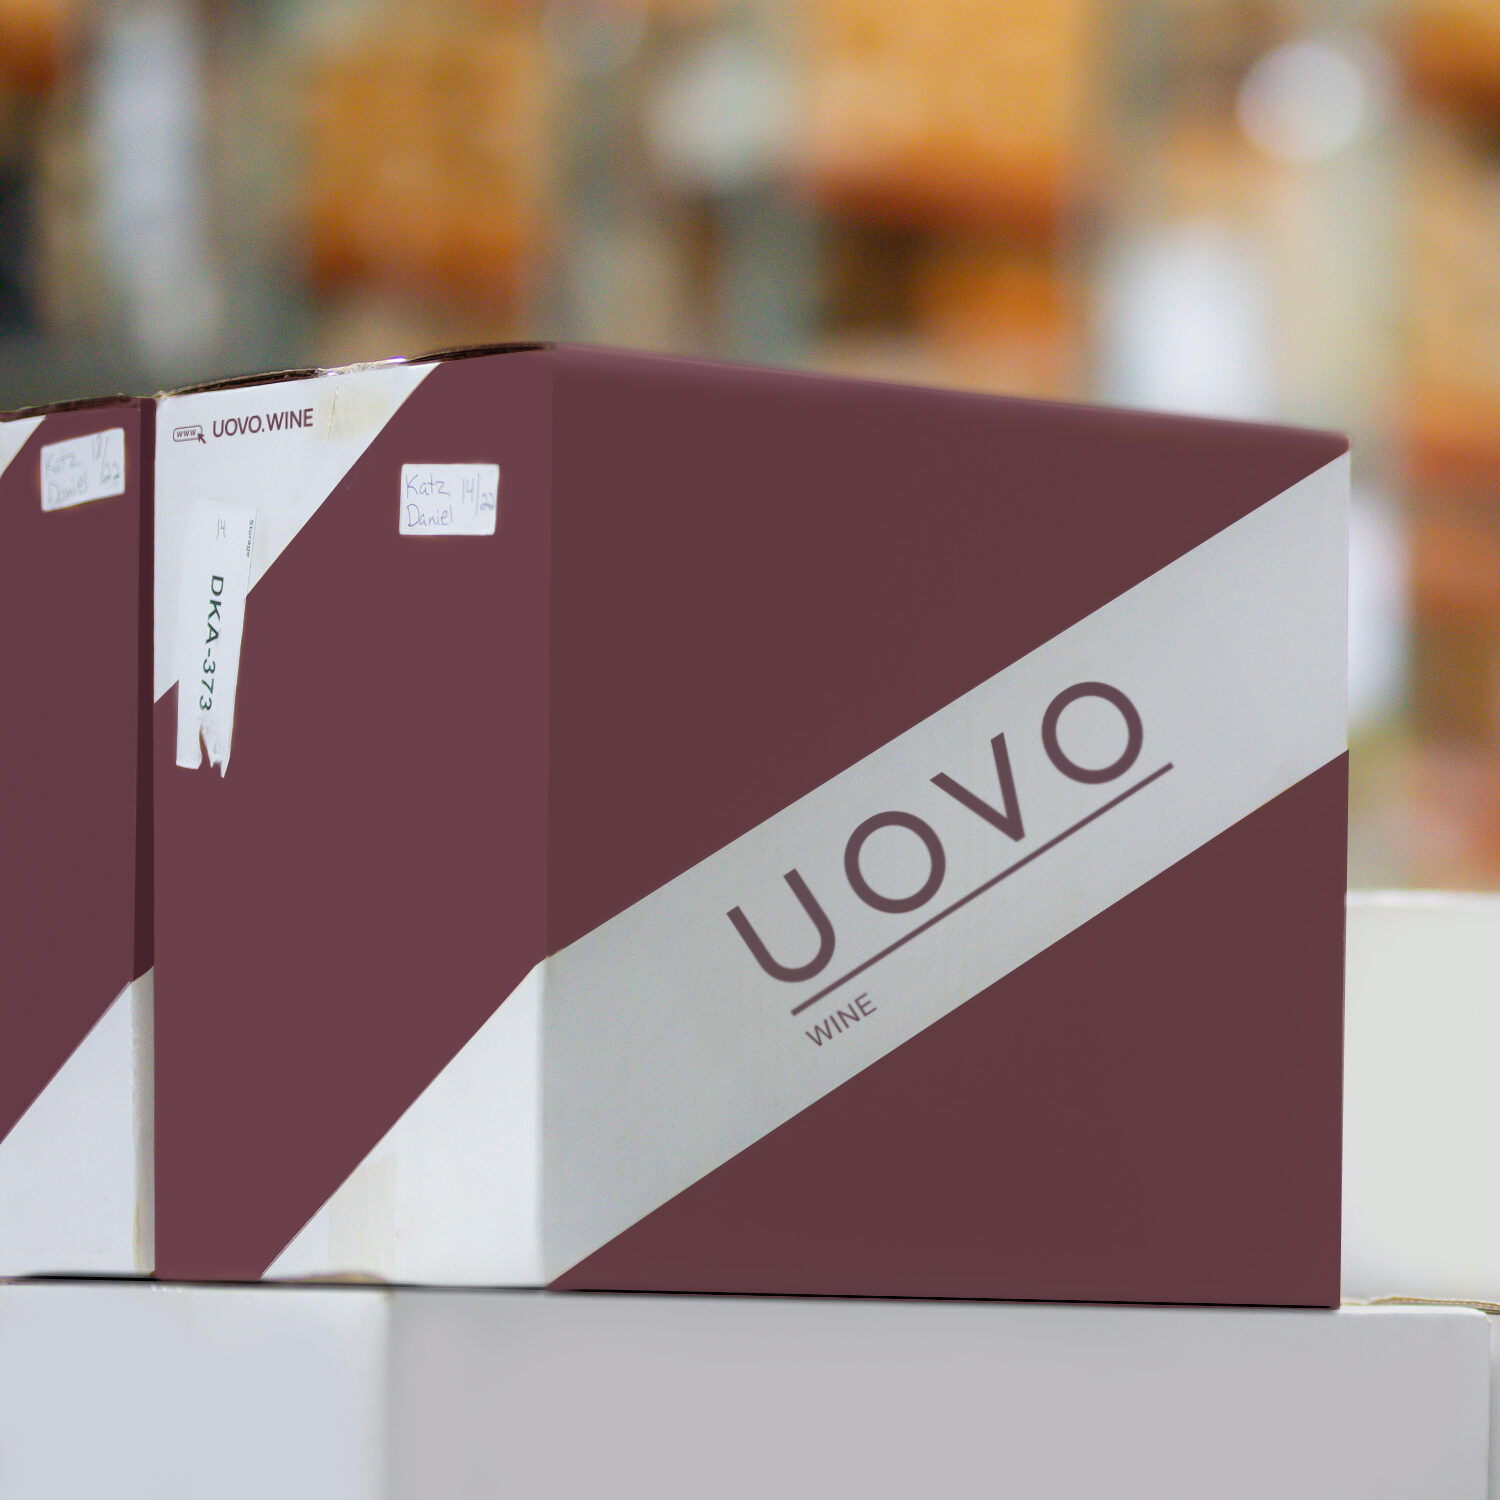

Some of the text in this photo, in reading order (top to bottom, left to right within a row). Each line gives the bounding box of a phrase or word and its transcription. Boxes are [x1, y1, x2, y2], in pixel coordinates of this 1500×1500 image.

[212, 407, 314, 438] UOVO.WINE
[405, 471, 451, 499] Katz
[406, 503, 453, 527] Daniel
[199, 574, 225, 711] DKA-373
[726, 681, 1144, 983] UOVO
[804, 992, 878, 1047] WINE
